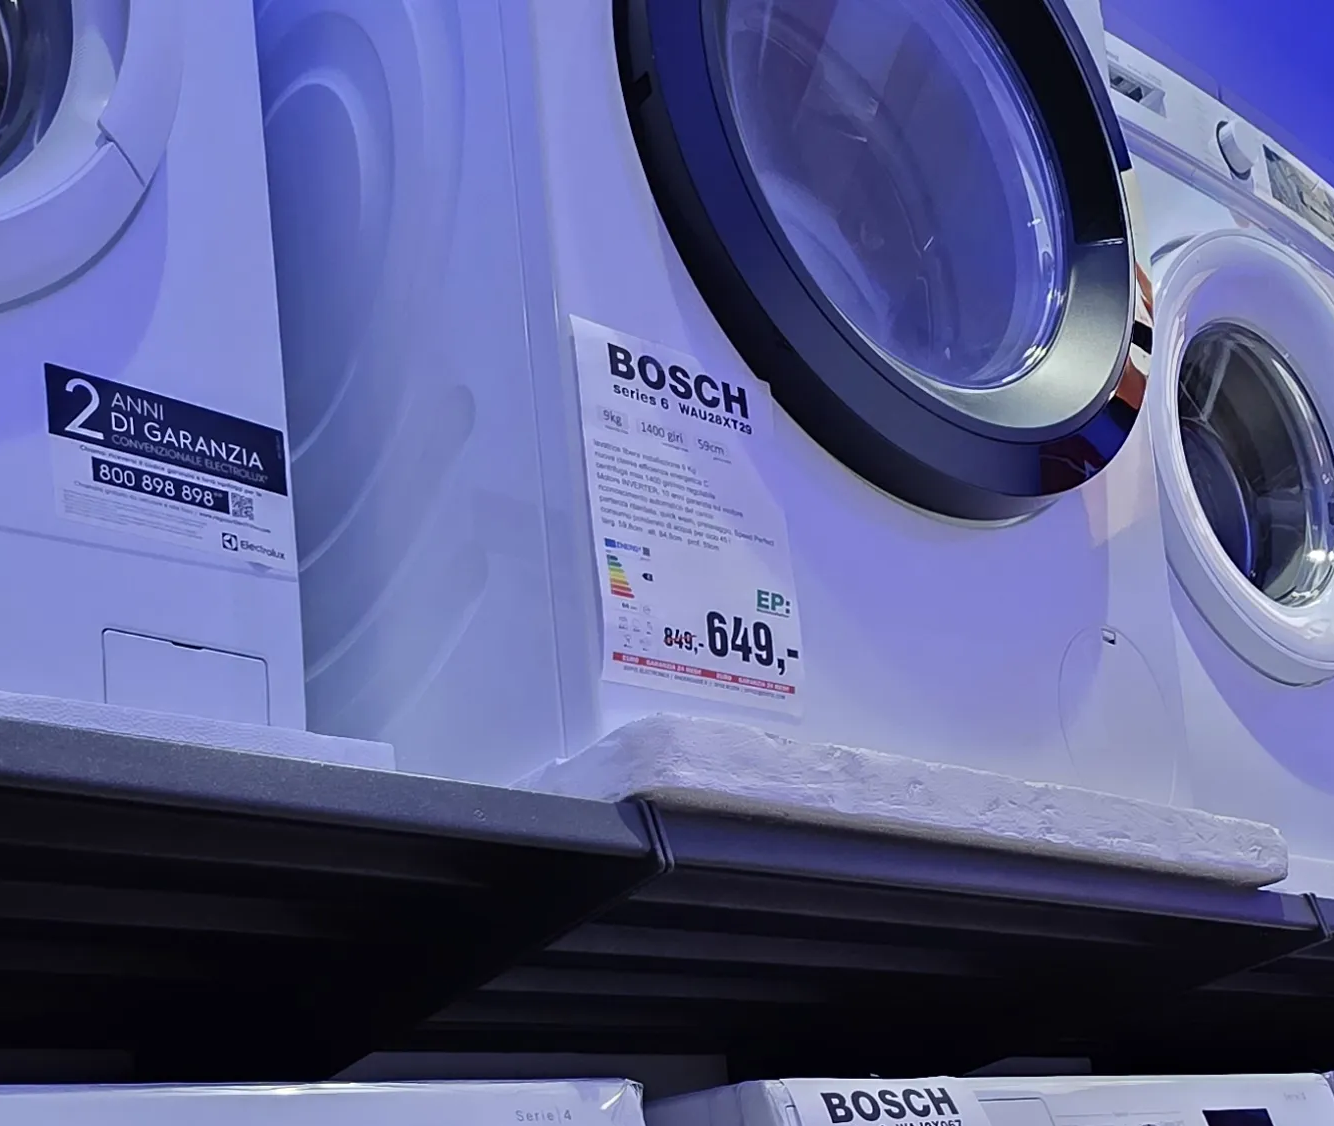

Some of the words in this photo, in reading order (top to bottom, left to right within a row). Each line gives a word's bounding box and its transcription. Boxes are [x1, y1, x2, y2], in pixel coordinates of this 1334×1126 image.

[607, 343, 749, 419] BOSCH
[64, 377, 104, 440] 2
[111, 392, 164, 421] ANNI
[613, 384, 656, 406] series
[660, 398, 669, 410] 6
[678, 403, 753, 435] WAU28XT29
[111, 412, 135, 435] DI
[143, 421, 265, 471] GARANZIA
[603, 409, 623, 427] 9kg
[641, 422, 665, 438] 1400
[667, 431, 684, 443] giri
[111, 434, 202, 466] CONVENZIONALE
[99, 464, 136, 487] 800
[141, 475, 176, 497] 898
[240, 540, 286, 561] Electrolux
[757, 589, 790, 614] EP:
[706, 611, 799, 675] 649,-
[820, 1088, 959, 1124] BOSCH
